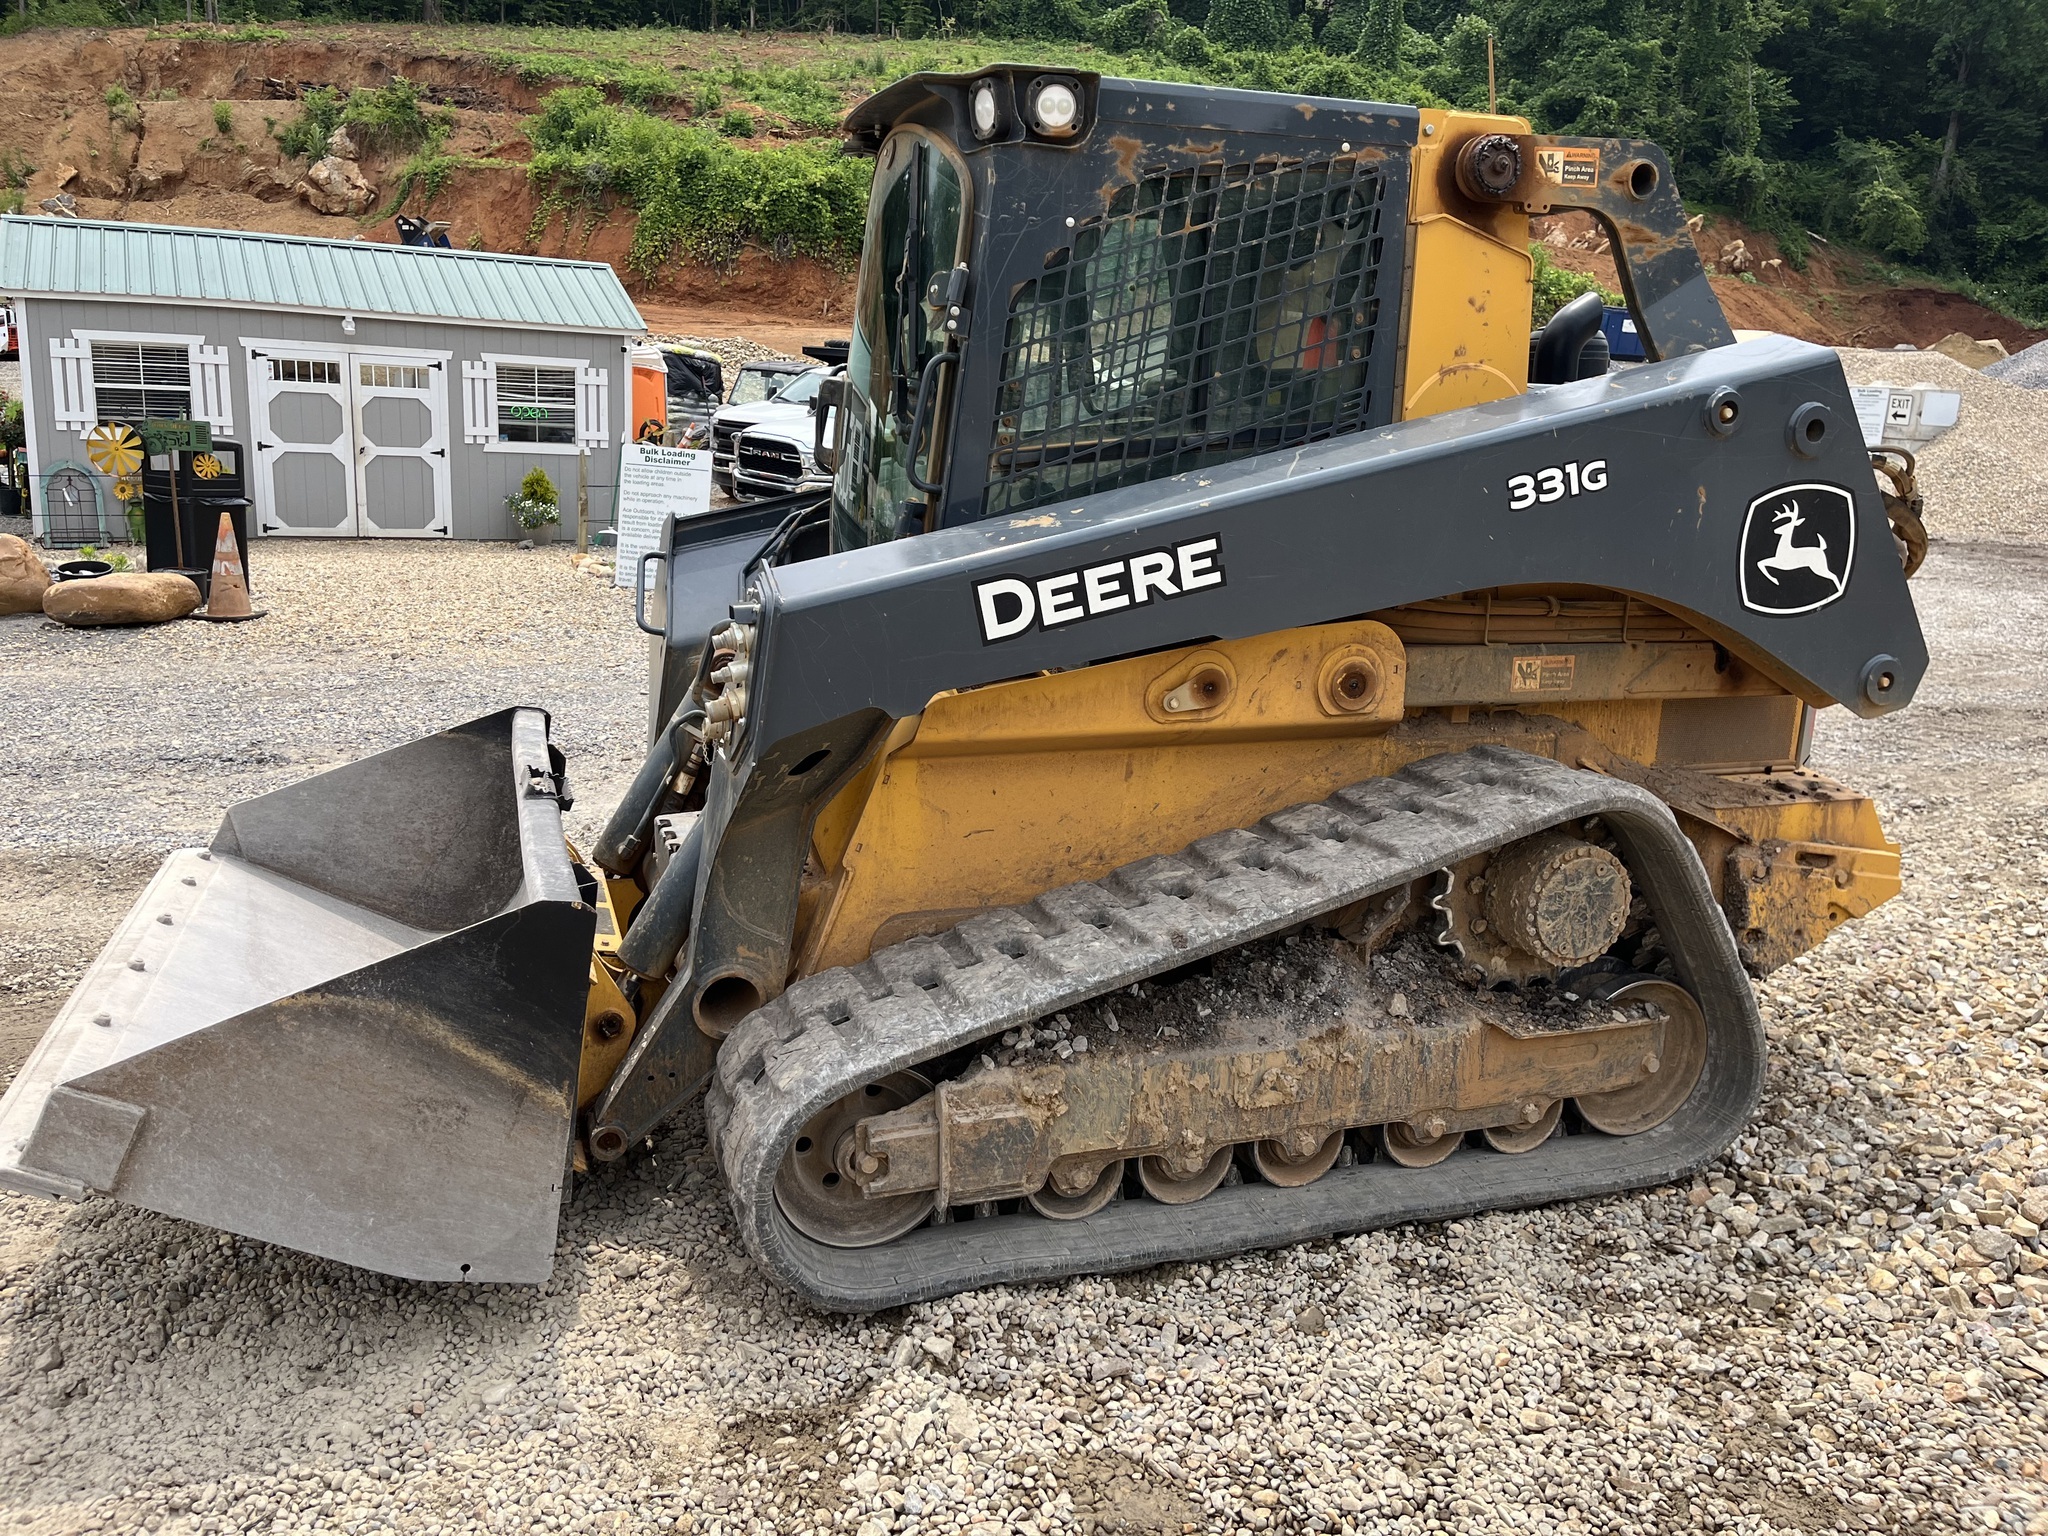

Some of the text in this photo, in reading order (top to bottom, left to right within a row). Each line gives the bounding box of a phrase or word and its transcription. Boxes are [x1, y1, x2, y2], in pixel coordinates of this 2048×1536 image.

[1891, 398, 1910, 409] EXIT
[640, 447, 696, 460] Bulk Loading
[752, 449, 780, 459] RAM
[644, 455, 691, 466] Disclaimer
[1508, 460, 1608, 510] 331G
[673, 494, 698, 503] machinery
[977, 538, 1222, 641] DEERE
